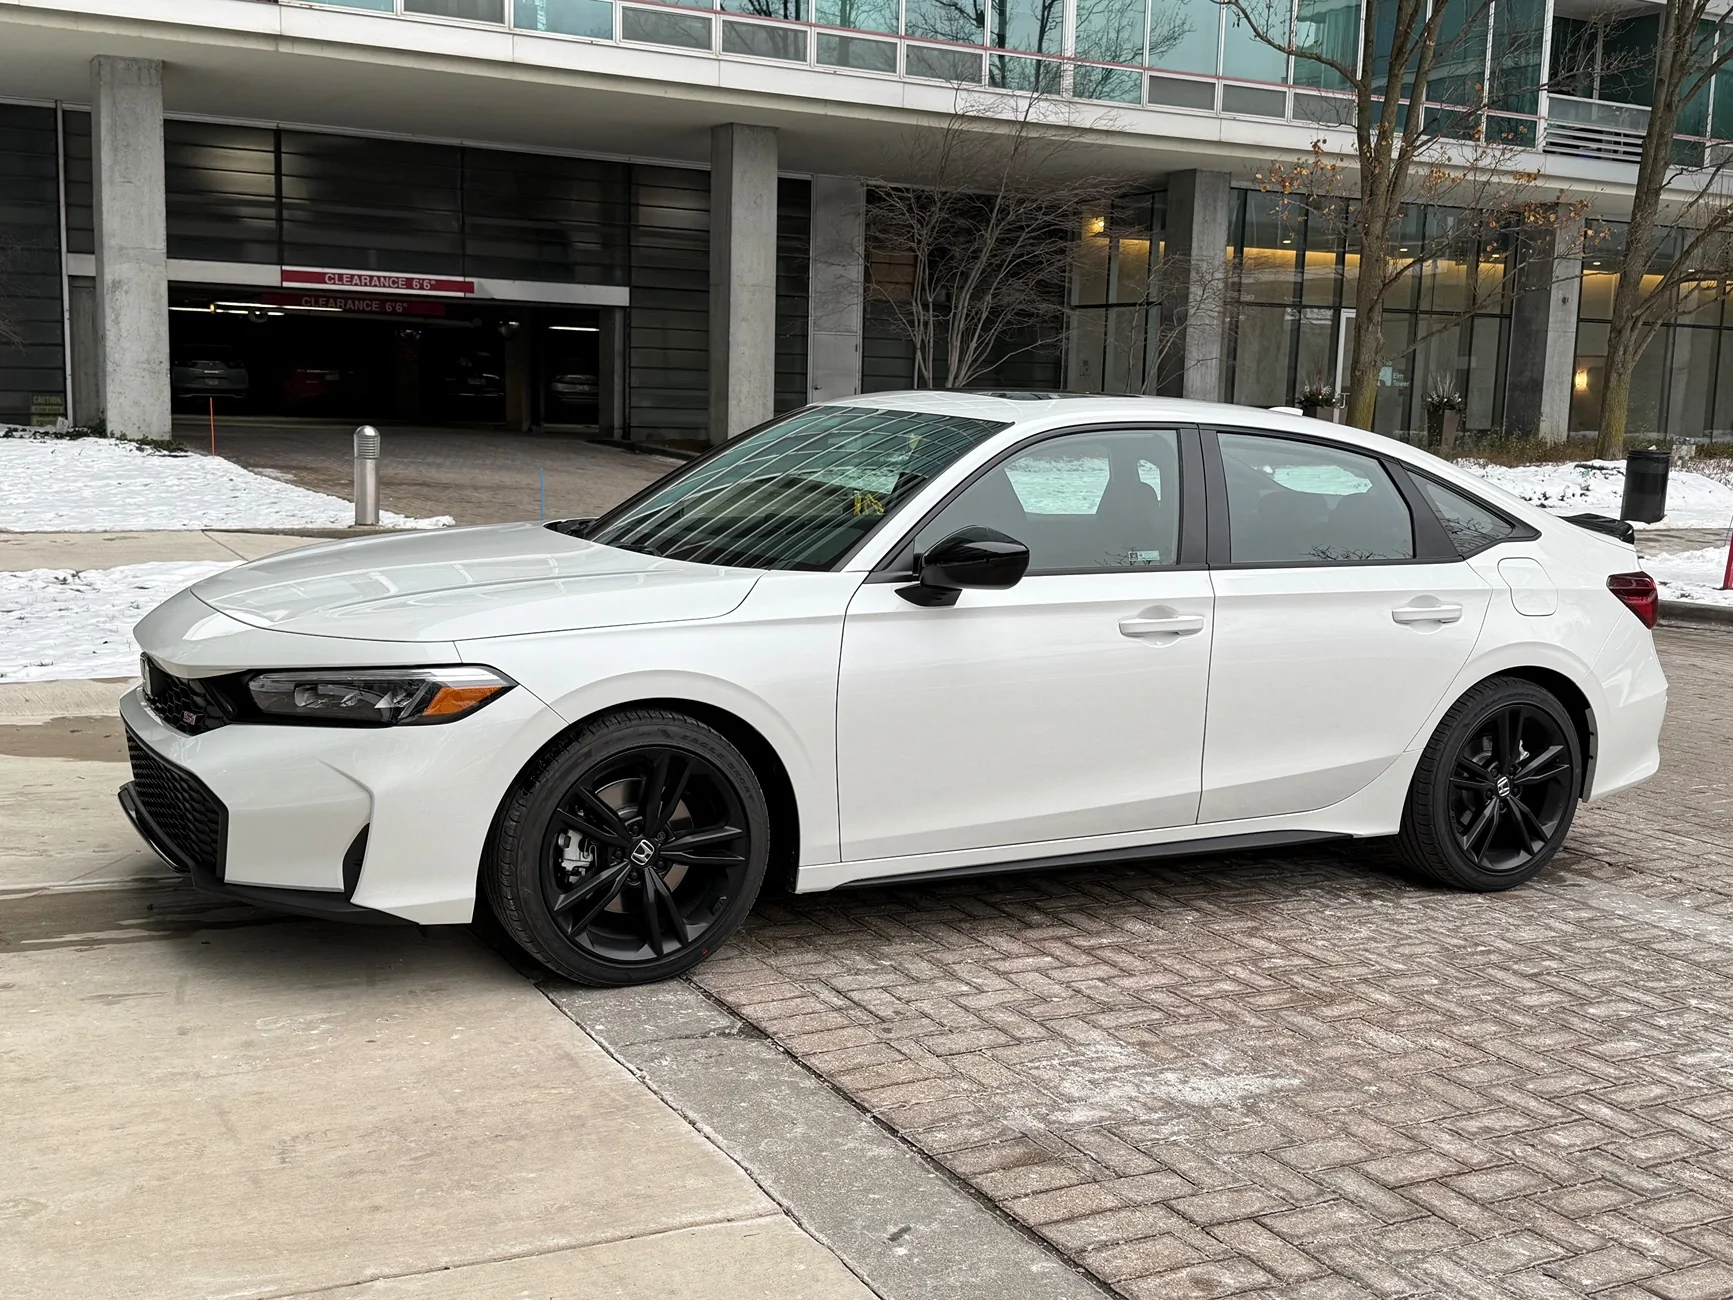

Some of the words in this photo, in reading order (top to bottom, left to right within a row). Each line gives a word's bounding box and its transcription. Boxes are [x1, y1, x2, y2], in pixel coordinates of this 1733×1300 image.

[325, 273, 407, 289] CLEARANCE
[412, 279, 436, 290] 6'6"
[301, 296, 380, 311] CLEARANCE
[33, 396, 62, 405] CAUTION
